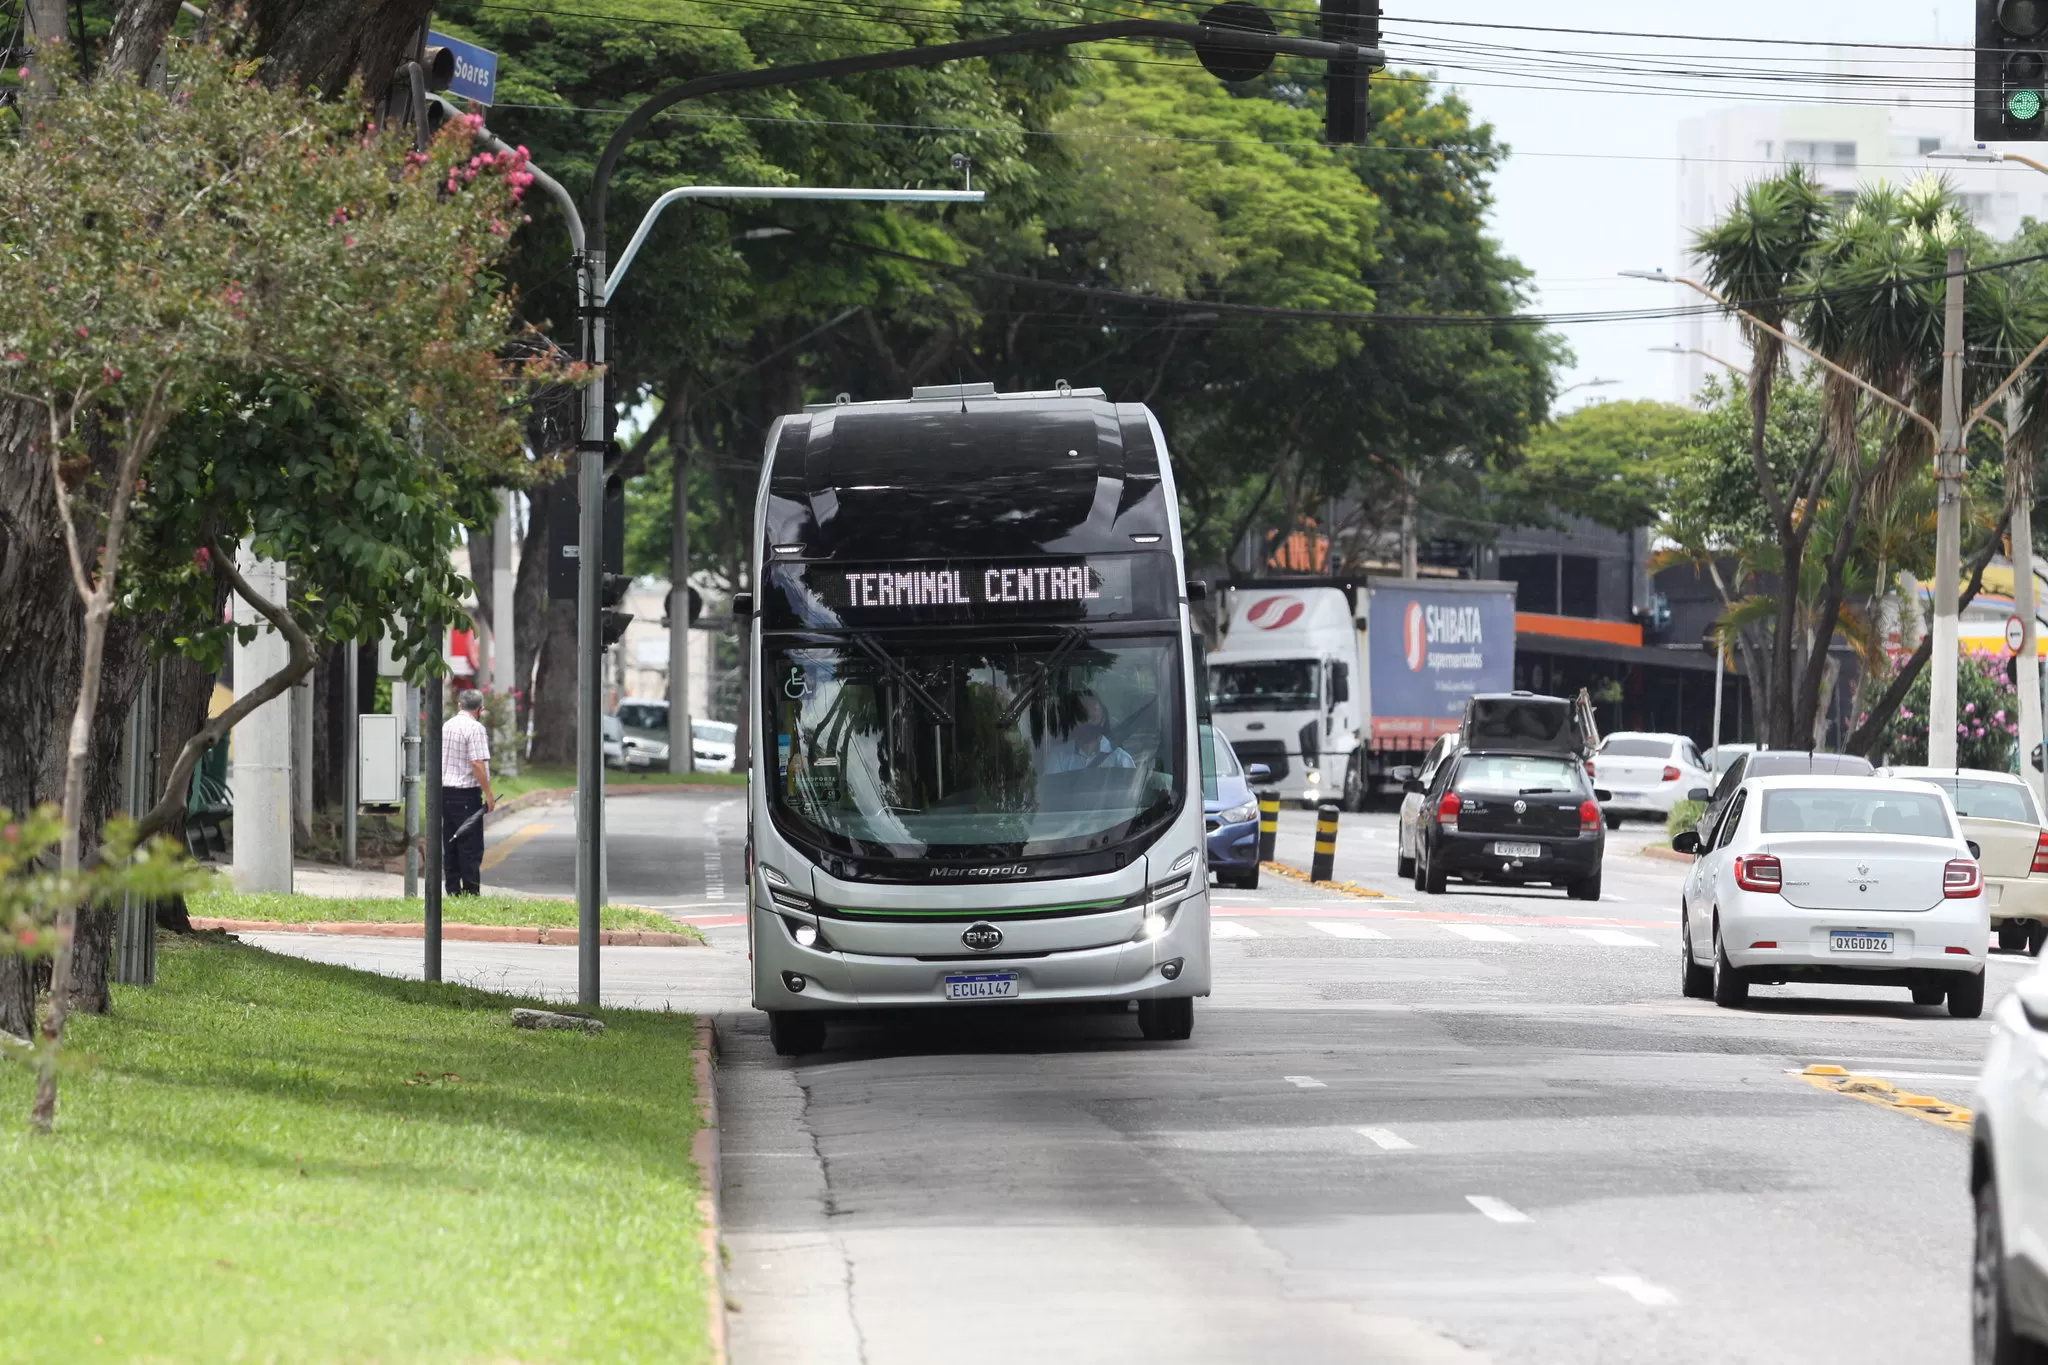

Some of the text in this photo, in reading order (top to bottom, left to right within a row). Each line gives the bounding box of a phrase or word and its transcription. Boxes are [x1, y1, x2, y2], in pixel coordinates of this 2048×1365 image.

[454, 55, 490, 87] Soares
[845, 566, 1101, 607] TERMINAL CENTRAL
[1425, 604, 1482, 644] SHIBATA
[929, 865, 1029, 878] Marcopolo
[966, 931, 999, 943] BYD
[953, 981, 1011, 997] ECU4I47
